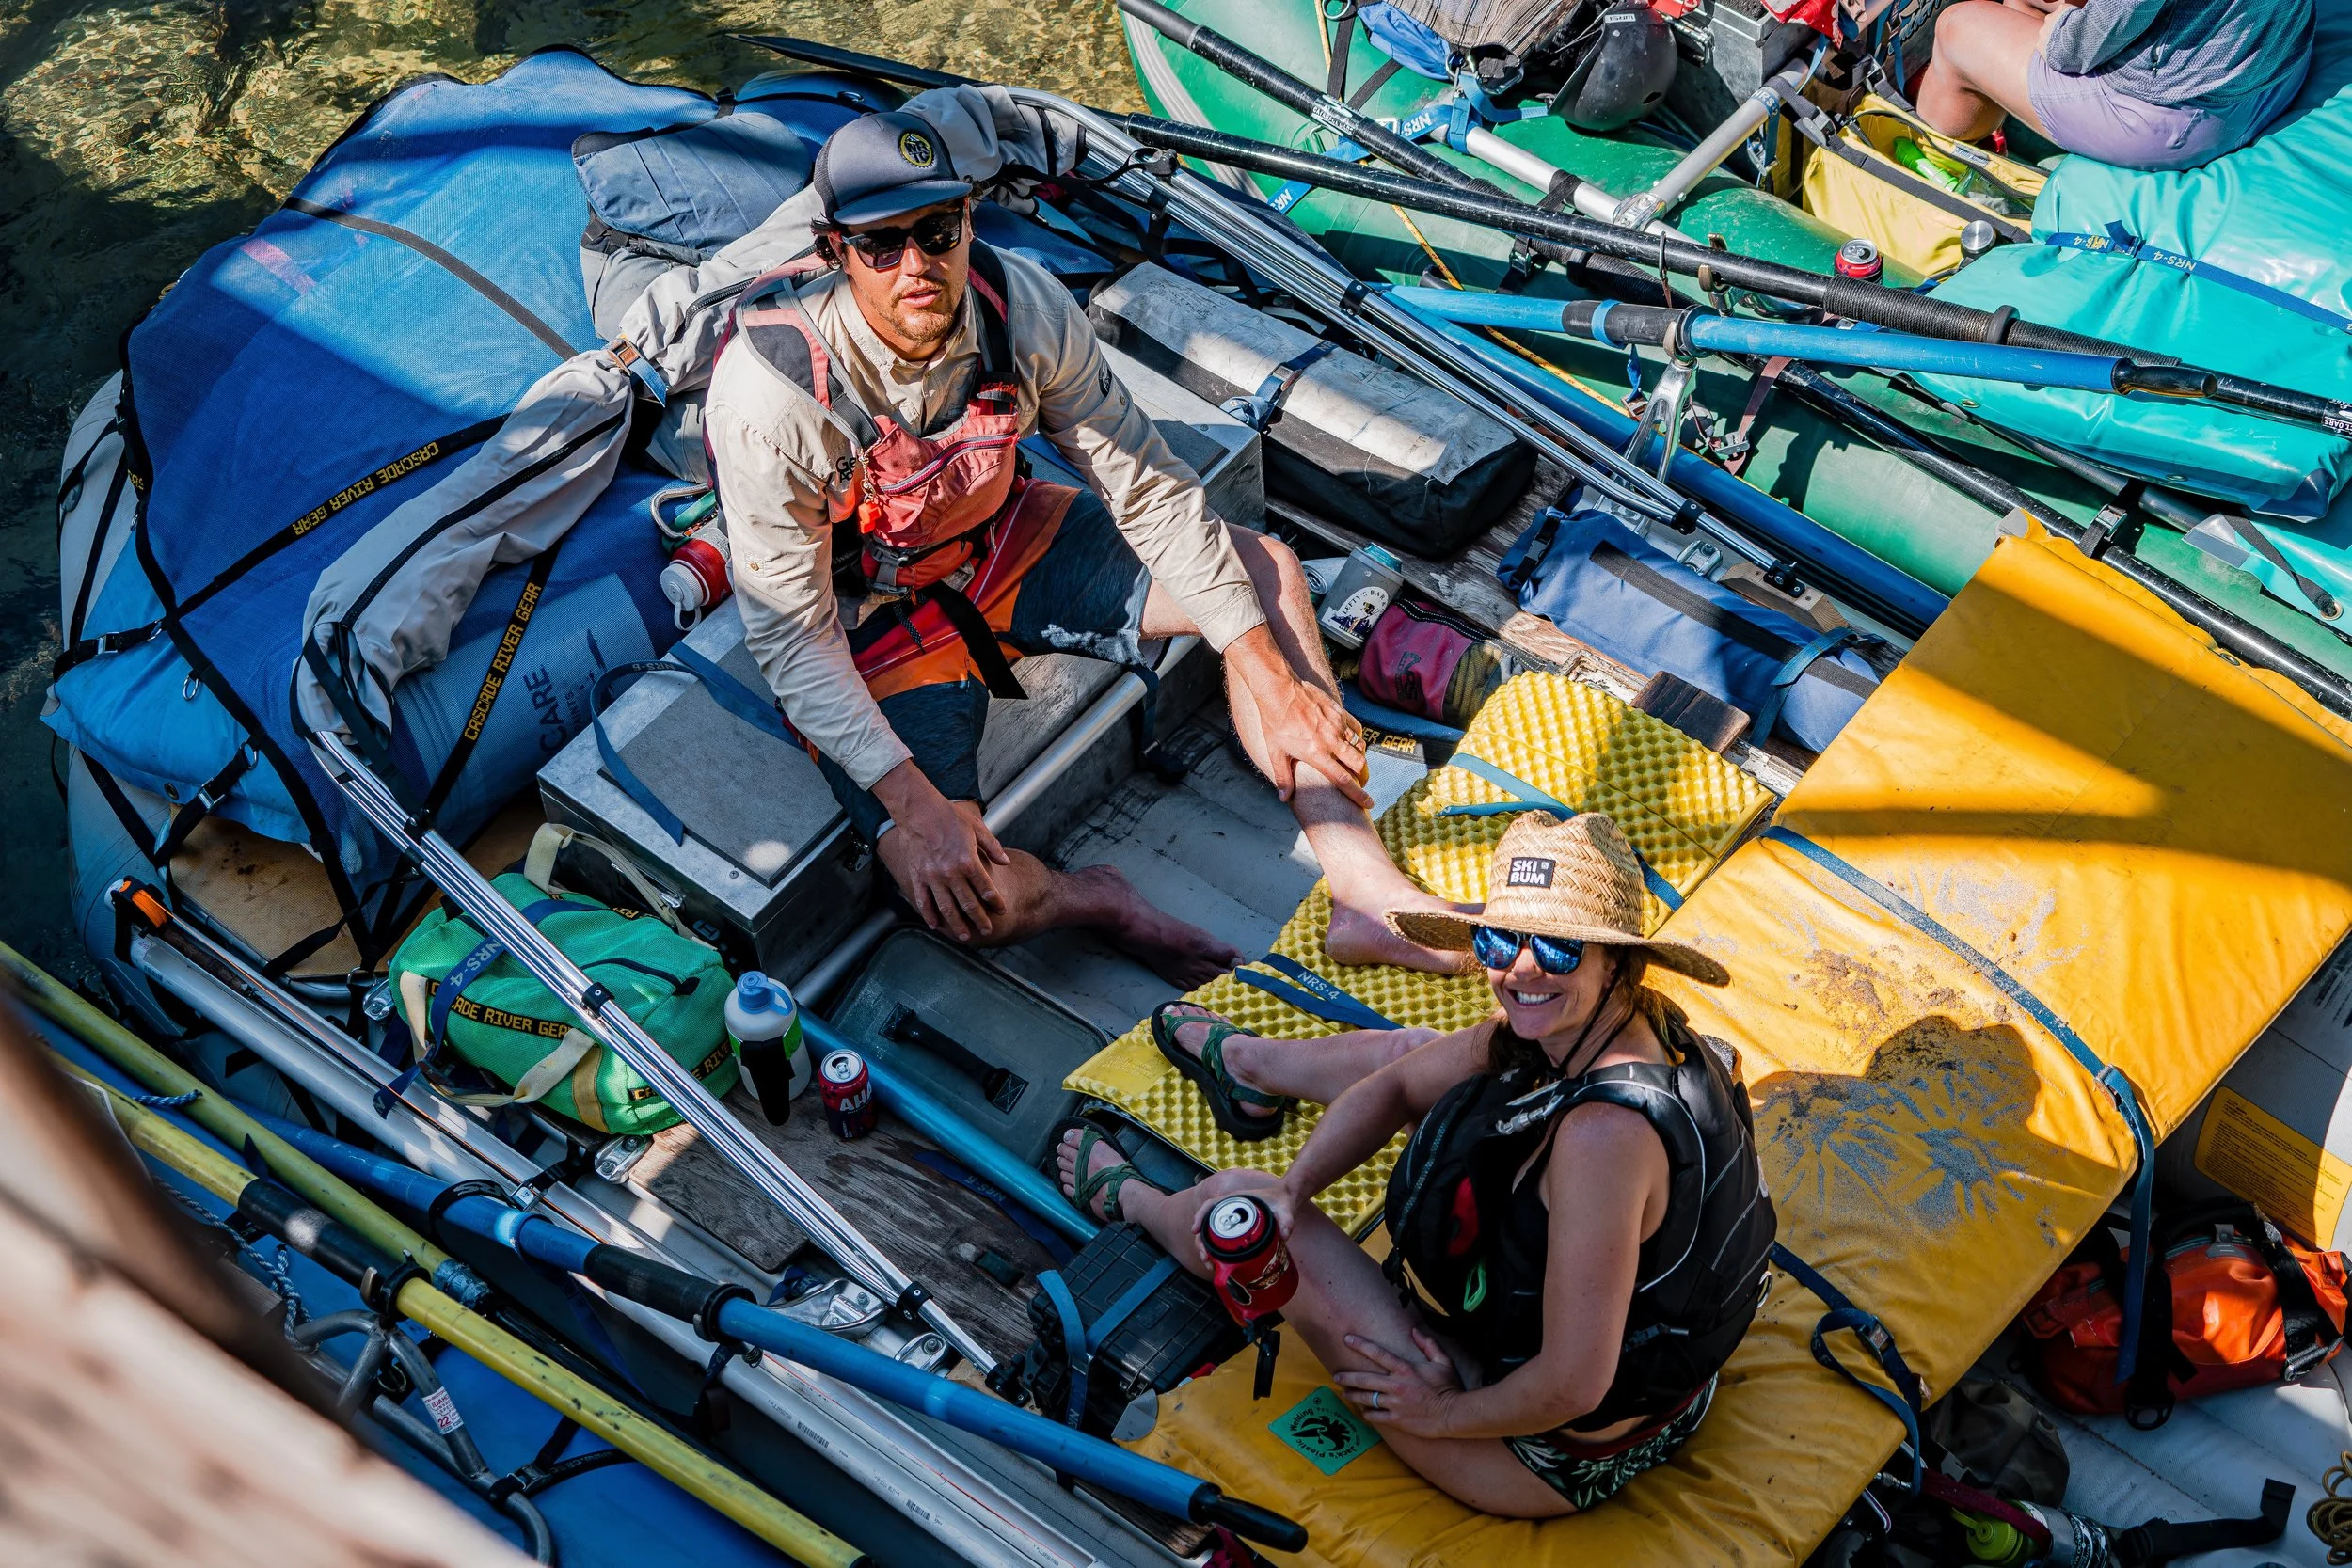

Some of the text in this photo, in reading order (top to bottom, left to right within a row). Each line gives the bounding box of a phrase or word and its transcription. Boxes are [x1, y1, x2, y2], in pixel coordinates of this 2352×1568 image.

[2153, 250, 2197, 272] NRS-4
[292, 441, 440, 536] CASCADE RIVER GEAR
[1341, 591, 1368, 615] LEFTY'S
[1370, 589, 1386, 600] BAR
[464, 581, 542, 741] CASCADE RIVER GEAR
[1380, 734, 1417, 754] GEAR
[1510, 871, 1546, 885] BUM
[1512, 859, 1538, 873] SKI
[450, 938, 502, 987] NRS-4
[1297, 970, 1341, 1000] NRS-4
[484, 1006, 532, 1032] RIVER
[437, 1416, 452, 1428] 22
[1289, 1407, 1315, 1432] Welding
[1295, 1438, 1326, 1459] Plastic
